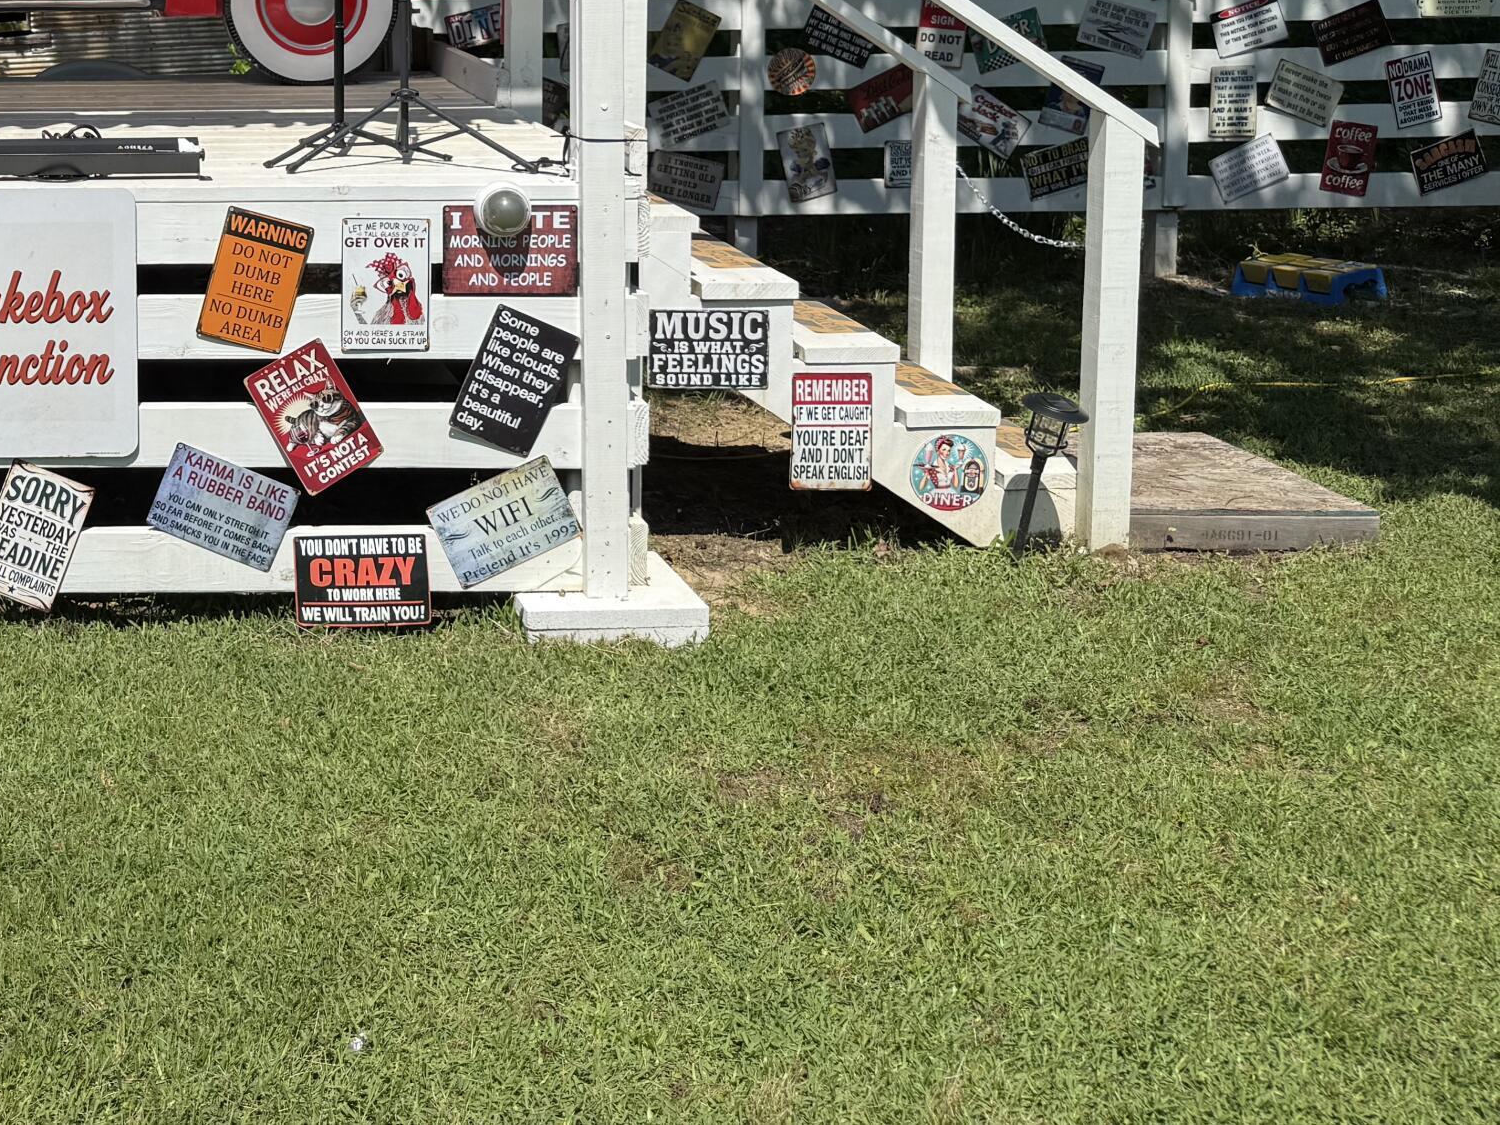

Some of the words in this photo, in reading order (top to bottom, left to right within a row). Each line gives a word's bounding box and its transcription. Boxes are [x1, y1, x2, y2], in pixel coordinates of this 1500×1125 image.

[1229, 0, 1260, 15] NOTICE
[931, 15, 955, 26] SIGN
[921, 33, 935, 42] DO
[938, 34, 962, 44] NOT
[925, 51, 953, 61] READ
[1388, 63, 1402, 78] NO
[1404, 55, 1430, 73] DRAMA
[1395, 75, 1432, 102] ZONE
[1334, 127, 1373, 143] coffee
[1421, 169, 1444, 184] THE
[1447, 155, 1479, 173] MANY
[1423, 176, 1458, 192] SERVICES
[1462, 165, 1484, 181] OFFER
[1325, 174, 1364, 189] coffee
[231, 214, 308, 249] WARNING
[450, 212, 462, 229] I
[345, 238, 369, 248] GET
[374, 238, 408, 248] OVER
[414, 238, 425, 247] IT
[450, 235, 516, 248] MORNING
[523, 235, 571, 249] PEOPLE
[232, 243, 254, 258] DO
[258, 249, 292, 268] NOT
[455, 254, 483, 267] AND
[490, 254, 566, 268] MORNINGS
[234, 262, 281, 285] DUMB
[469, 274, 498, 286] AND
[504, 273, 551, 286] PEOPLE
[231, 281, 274, 303] HERE
[210, 299, 232, 315] NO
[236, 306, 283, 328] DUMB
[499, 310, 539, 336] Some
[219, 321, 262, 342] AREA
[655, 312, 763, 340] MUSIC
[491, 327, 539, 353] people
[541, 347, 564, 364] are
[674, 342, 689, 353] IS
[693, 341, 744, 353] WHAT
[486, 338, 510, 357] like
[513, 353, 560, 380] clouds.
[652, 354, 765, 374] FEELINGS
[255, 349, 325, 400] RELAX
[656, 374, 713, 386] SOUND
[721, 374, 760, 386] LIKE
[796, 380, 868, 402] REMEMBER
[796, 431, 835, 446] YOU'RE
[840, 431, 868, 445] DEAF
[304, 455, 331, 477] IT'S
[333, 439, 358, 461] NOT
[358, 433, 368, 445] A
[319, 446, 370, 483] CONTEST
[800, 448, 822, 463] AND
[826, 448, 829, 463] I
[833, 447, 864, 463] DON'T
[185, 451, 235, 483] KARMA
[239, 473, 254, 489] IS
[256, 480, 289, 504] LIKE
[793, 465, 825, 480] SPEAK
[828, 465, 868, 480] ENGLISH
[5, 475, 86, 526] SORRY
[172, 466, 182, 480] A
[187, 471, 244, 505] RUBBER
[246, 496, 286, 521] BAND
[922, 492, 973, 507] DINER
[0, 503, 76, 546] YESTERDAY
[473, 497, 533, 536] WIFI
[45, 541, 68, 559] THE
[310, 557, 415, 587] CRAZY
